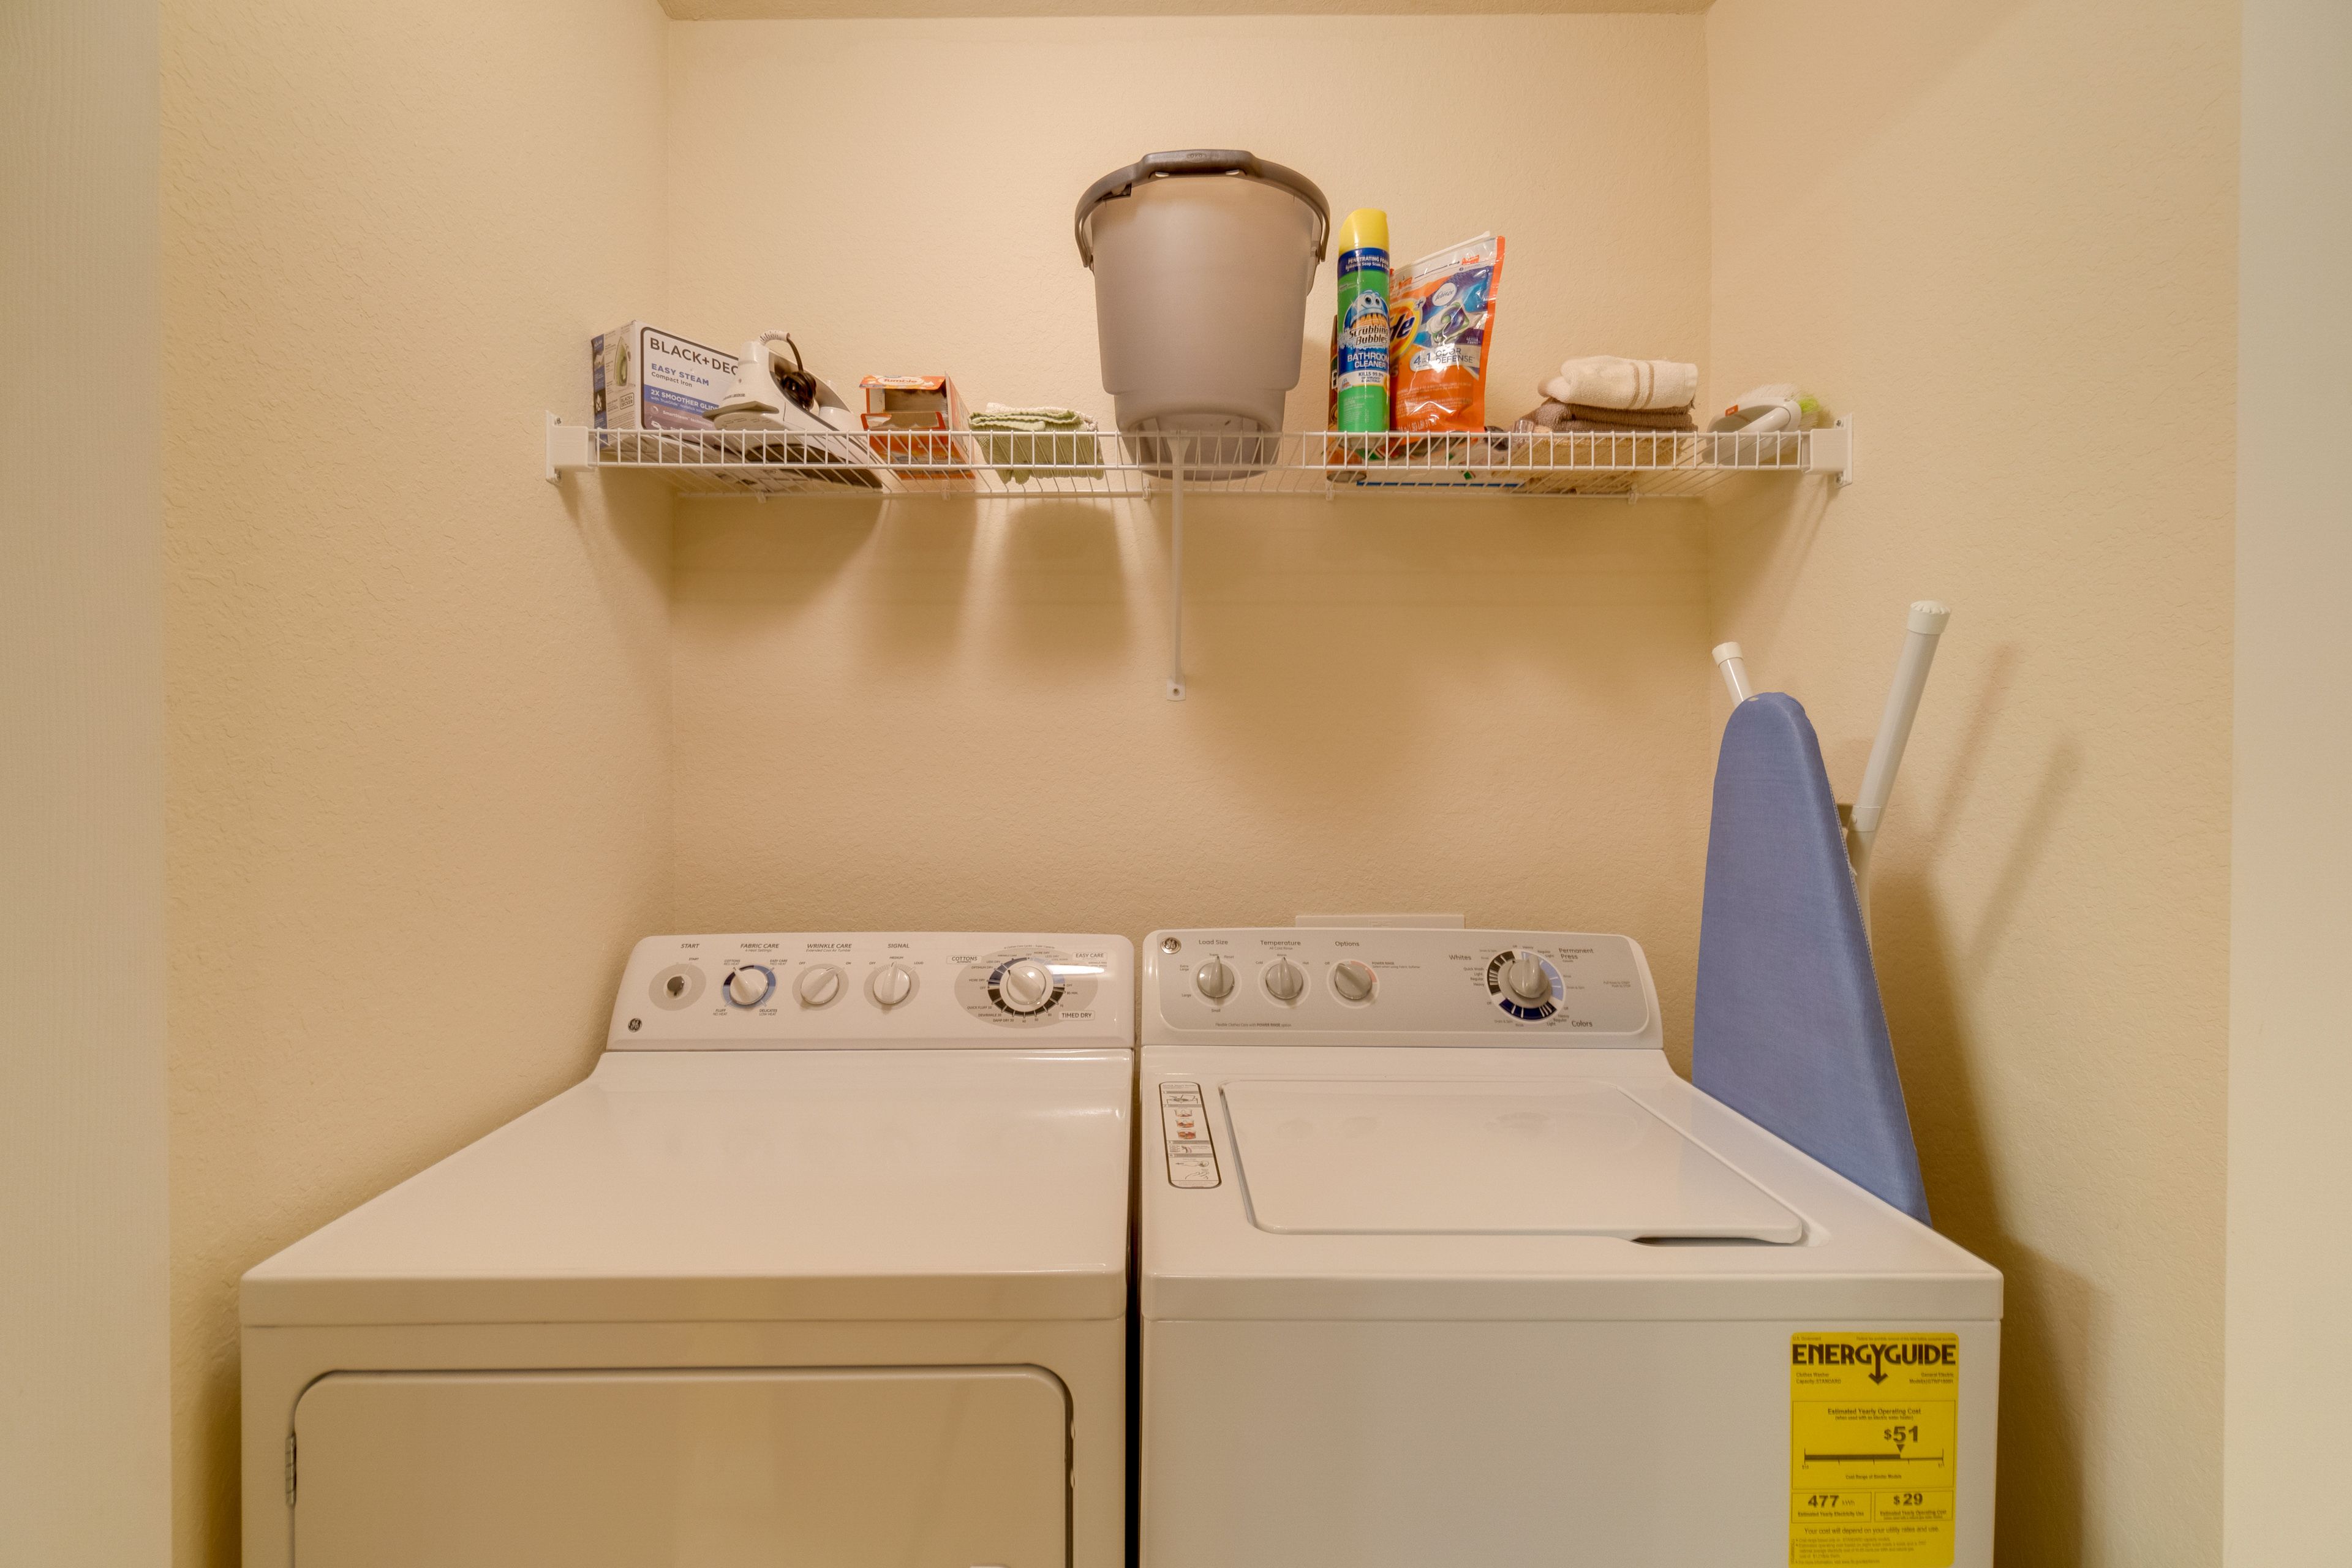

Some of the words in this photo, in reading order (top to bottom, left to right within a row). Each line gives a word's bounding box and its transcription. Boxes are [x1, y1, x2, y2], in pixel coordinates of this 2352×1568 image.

[1349, 325, 1388, 339] Scrubbing
[1355, 334, 1387, 345] Bubbles
[1436, 347, 1461, 357] ODOR
[1354, 360, 1386, 369] CLEANER
[1414, 355, 1421, 365] 4
[652, 363, 677, 375] EASY
[679, 372, 709, 386] STEAM
[652, 371, 679, 383] Compact
[680, 379, 693, 388] Iron
[662, 392, 699, 407] SMOOTHER
[1792, 1343, 1956, 1366] ENERGYGUIDE
[1884, 1425, 1918, 1443] $51
[1807, 1494, 1839, 1508] 477
